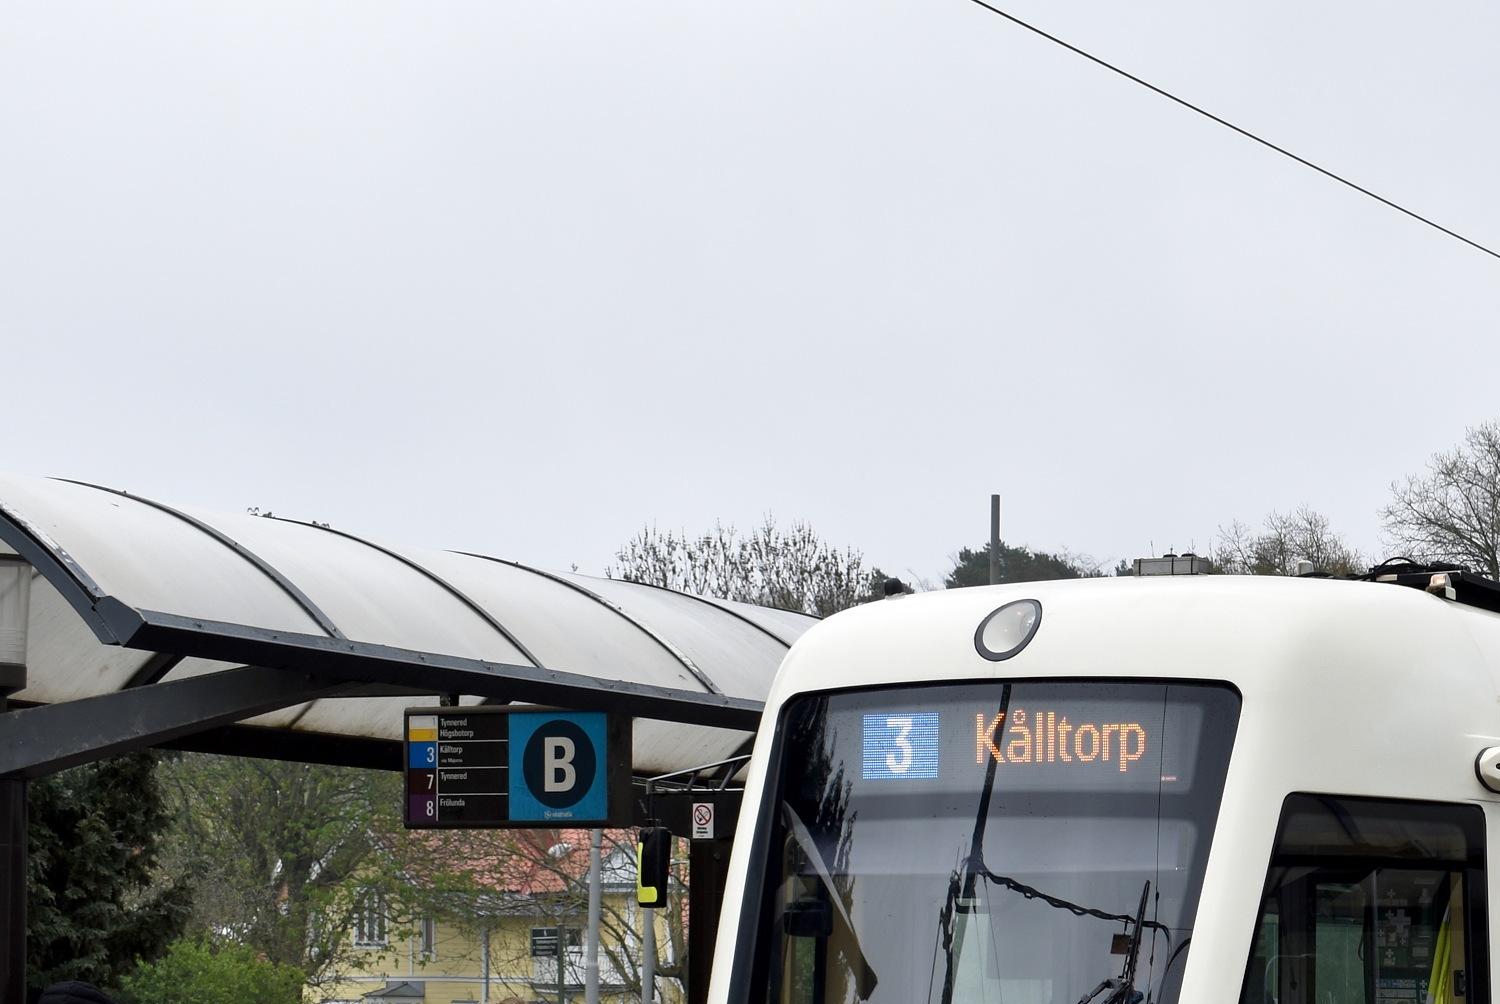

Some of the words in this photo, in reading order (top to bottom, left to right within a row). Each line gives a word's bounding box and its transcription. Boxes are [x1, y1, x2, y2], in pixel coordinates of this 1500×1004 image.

[441, 718, 467, 728] Tynnered
[440, 729, 474, 738] Högsbotorp
[976, 709, 1146, 772] Kålltorp
[440, 745, 463, 754] Kålltorp
[886, 717, 913, 774] 3
[426, 747, 434, 762] 3
[544, 736, 576, 792] B
[426, 774, 434, 790] 7
[441, 772, 468, 781] Tynnered
[426, 800, 434, 816] 8
[440, 799, 465, 807] Frölunda
